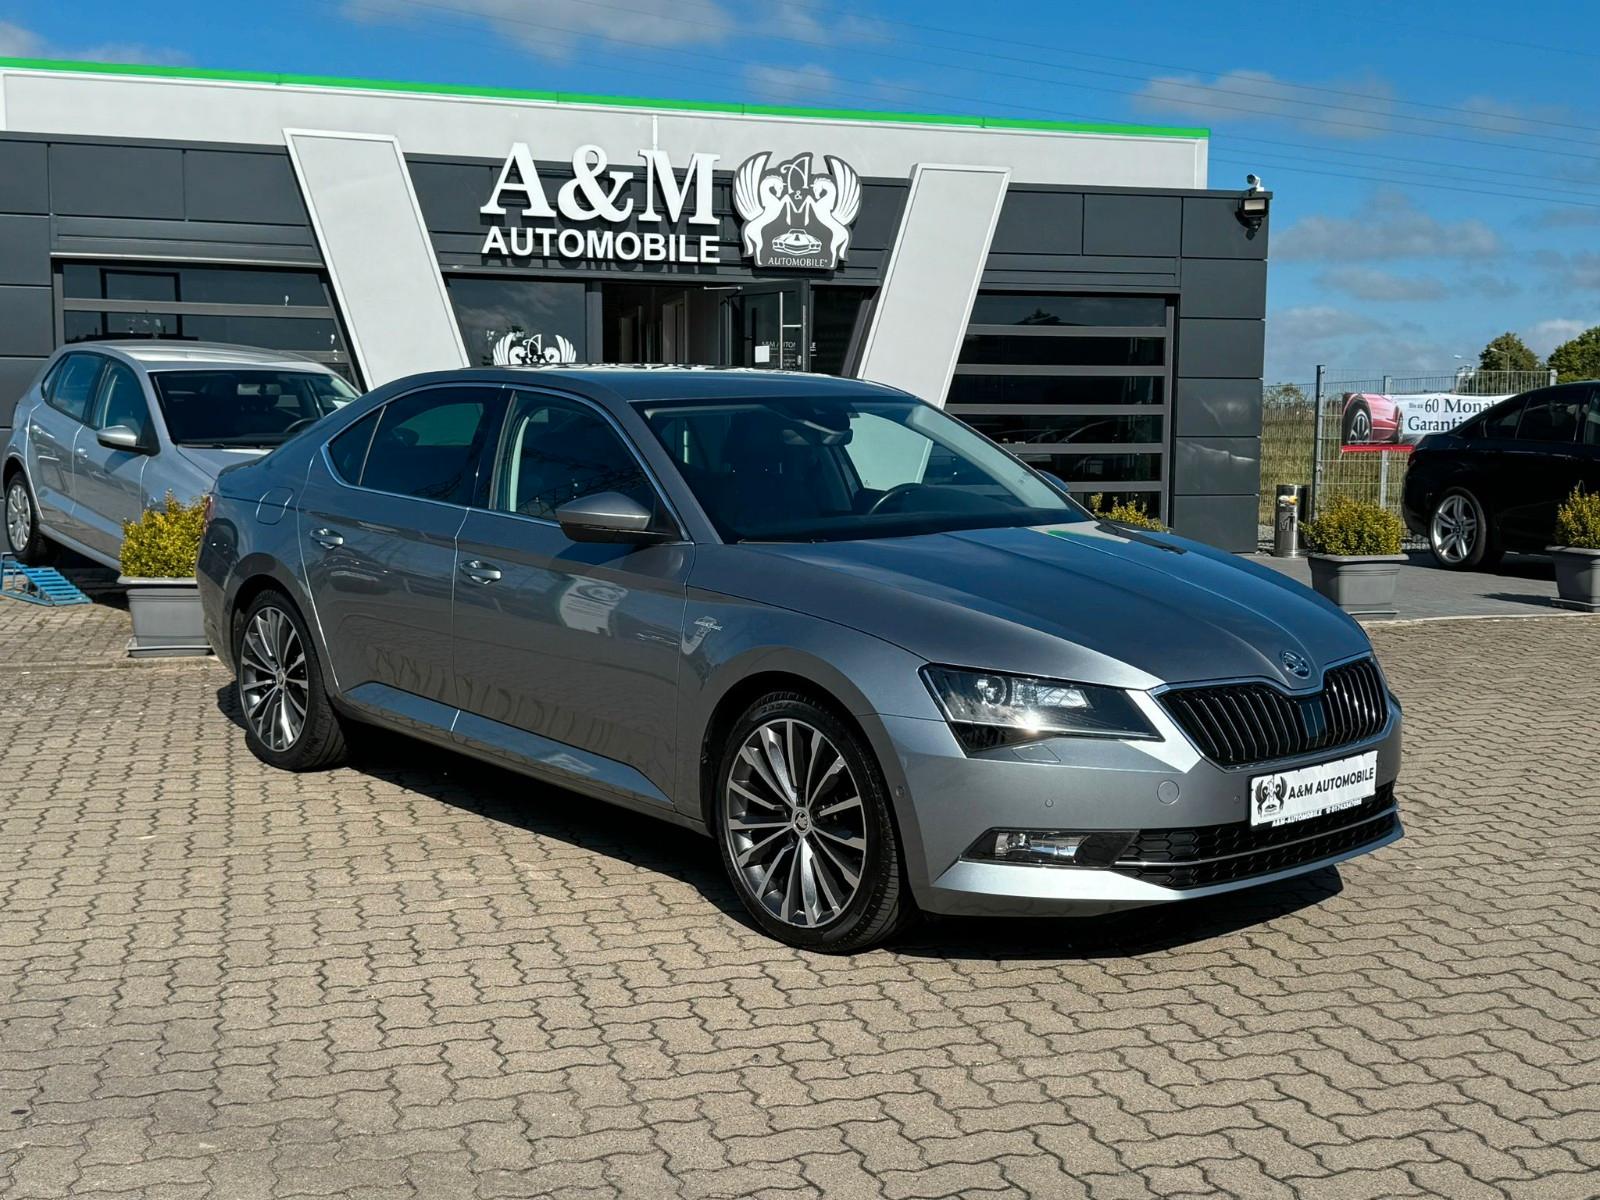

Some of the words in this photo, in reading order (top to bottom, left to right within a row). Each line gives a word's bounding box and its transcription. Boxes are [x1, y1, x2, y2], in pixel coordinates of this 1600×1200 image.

[480, 142, 720, 225] A&M
[481, 226, 720, 263] AUTOMOBILE
[1425, 399, 1439, 413] 60
[1288, 783, 1314, 800] A&M
[1315, 767, 1375, 794] AUTOMOBILE
